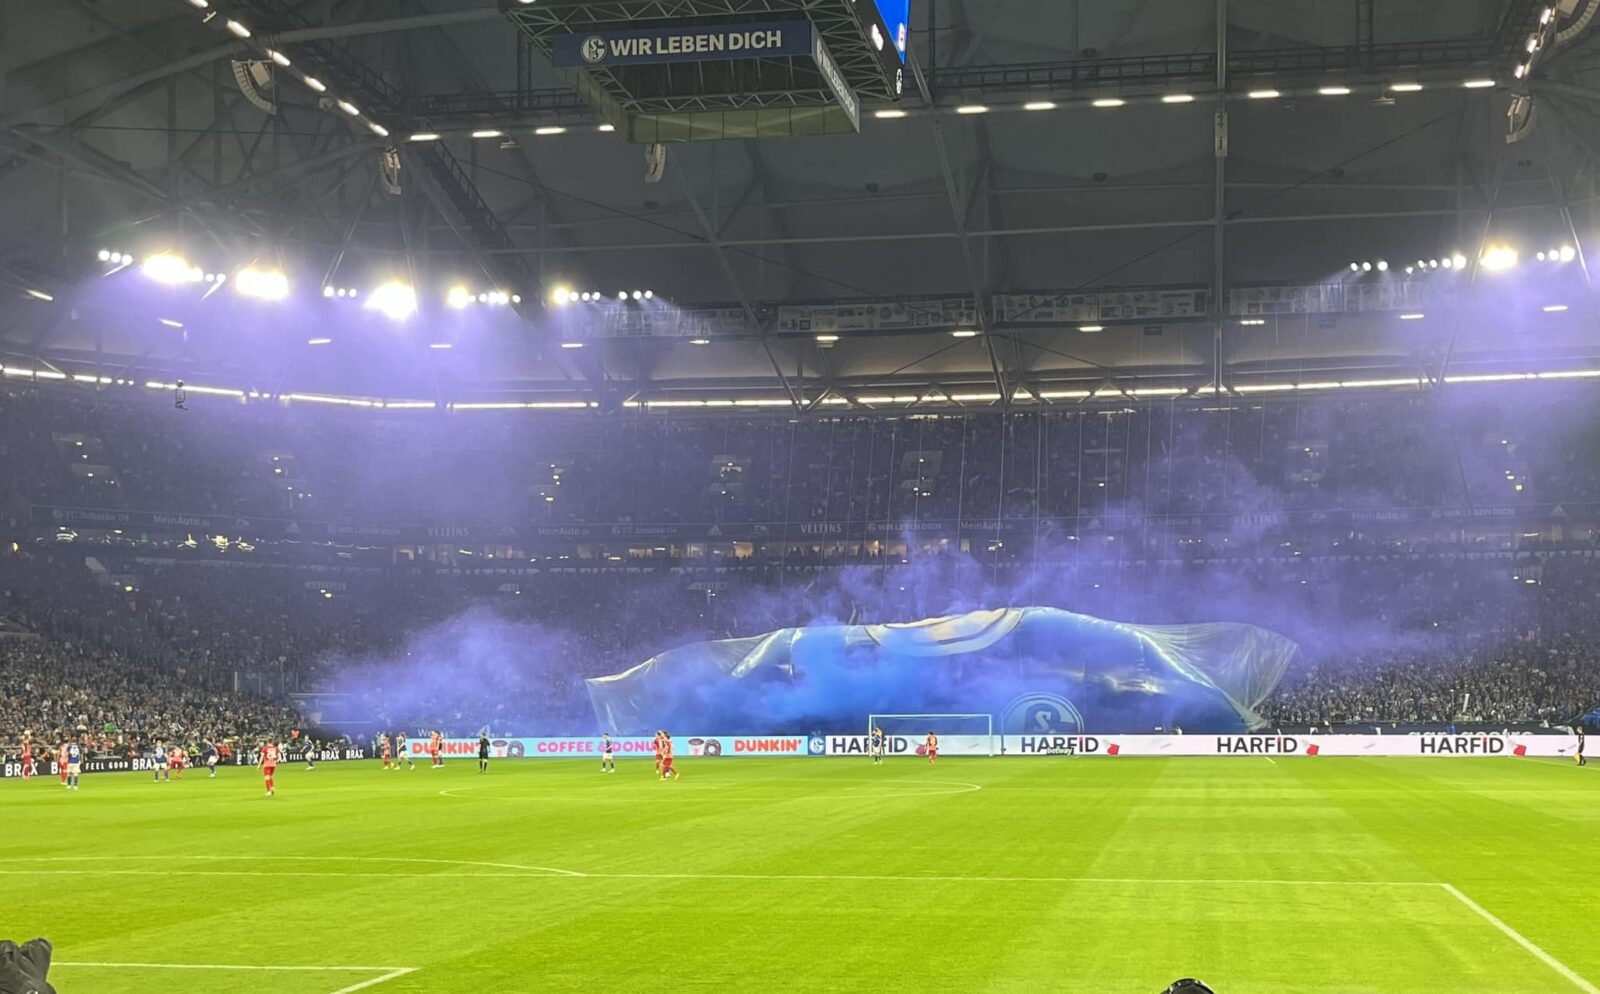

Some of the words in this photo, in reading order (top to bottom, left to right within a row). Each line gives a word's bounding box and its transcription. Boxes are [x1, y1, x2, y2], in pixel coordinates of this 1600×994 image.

[609, 38, 652, 56] WIR
[656, 34, 724, 54] LEBEN
[728, 30, 782, 50] DICH
[800, 523, 842, 534] VELTINS
[537, 741, 593, 753] COFFEE
[734, 739, 802, 752] DUNKIN'
[320, 750, 340, 761] BRAX
[345, 749, 364, 760] BRAX
[85, 763, 105, 771] FEEL
[108, 761, 129, 770] GOOD
